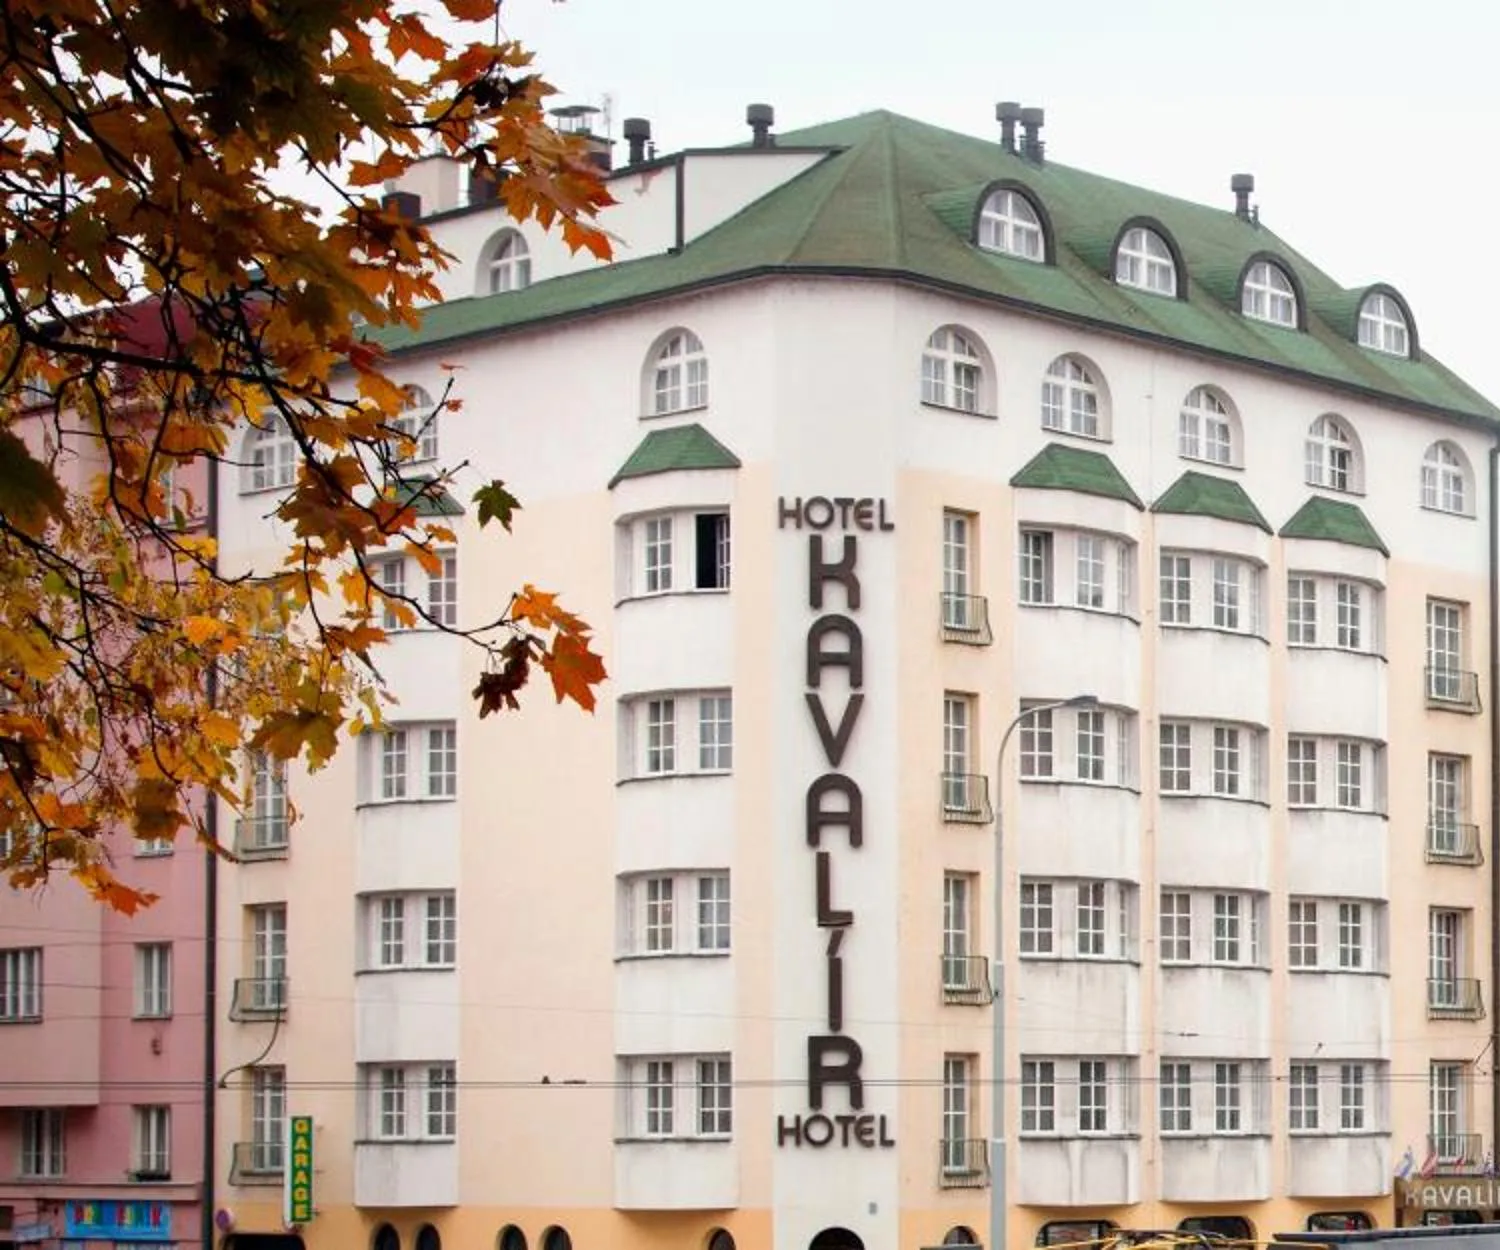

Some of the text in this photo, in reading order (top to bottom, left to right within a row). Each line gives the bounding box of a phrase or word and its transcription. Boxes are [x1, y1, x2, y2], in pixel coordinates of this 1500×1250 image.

[778, 496, 895, 531] HOTEL
[804, 534, 865, 1111] KAVALÍR
[777, 1115, 895, 1147] HOTEL
[294, 1119, 308, 1218] GARAGE
